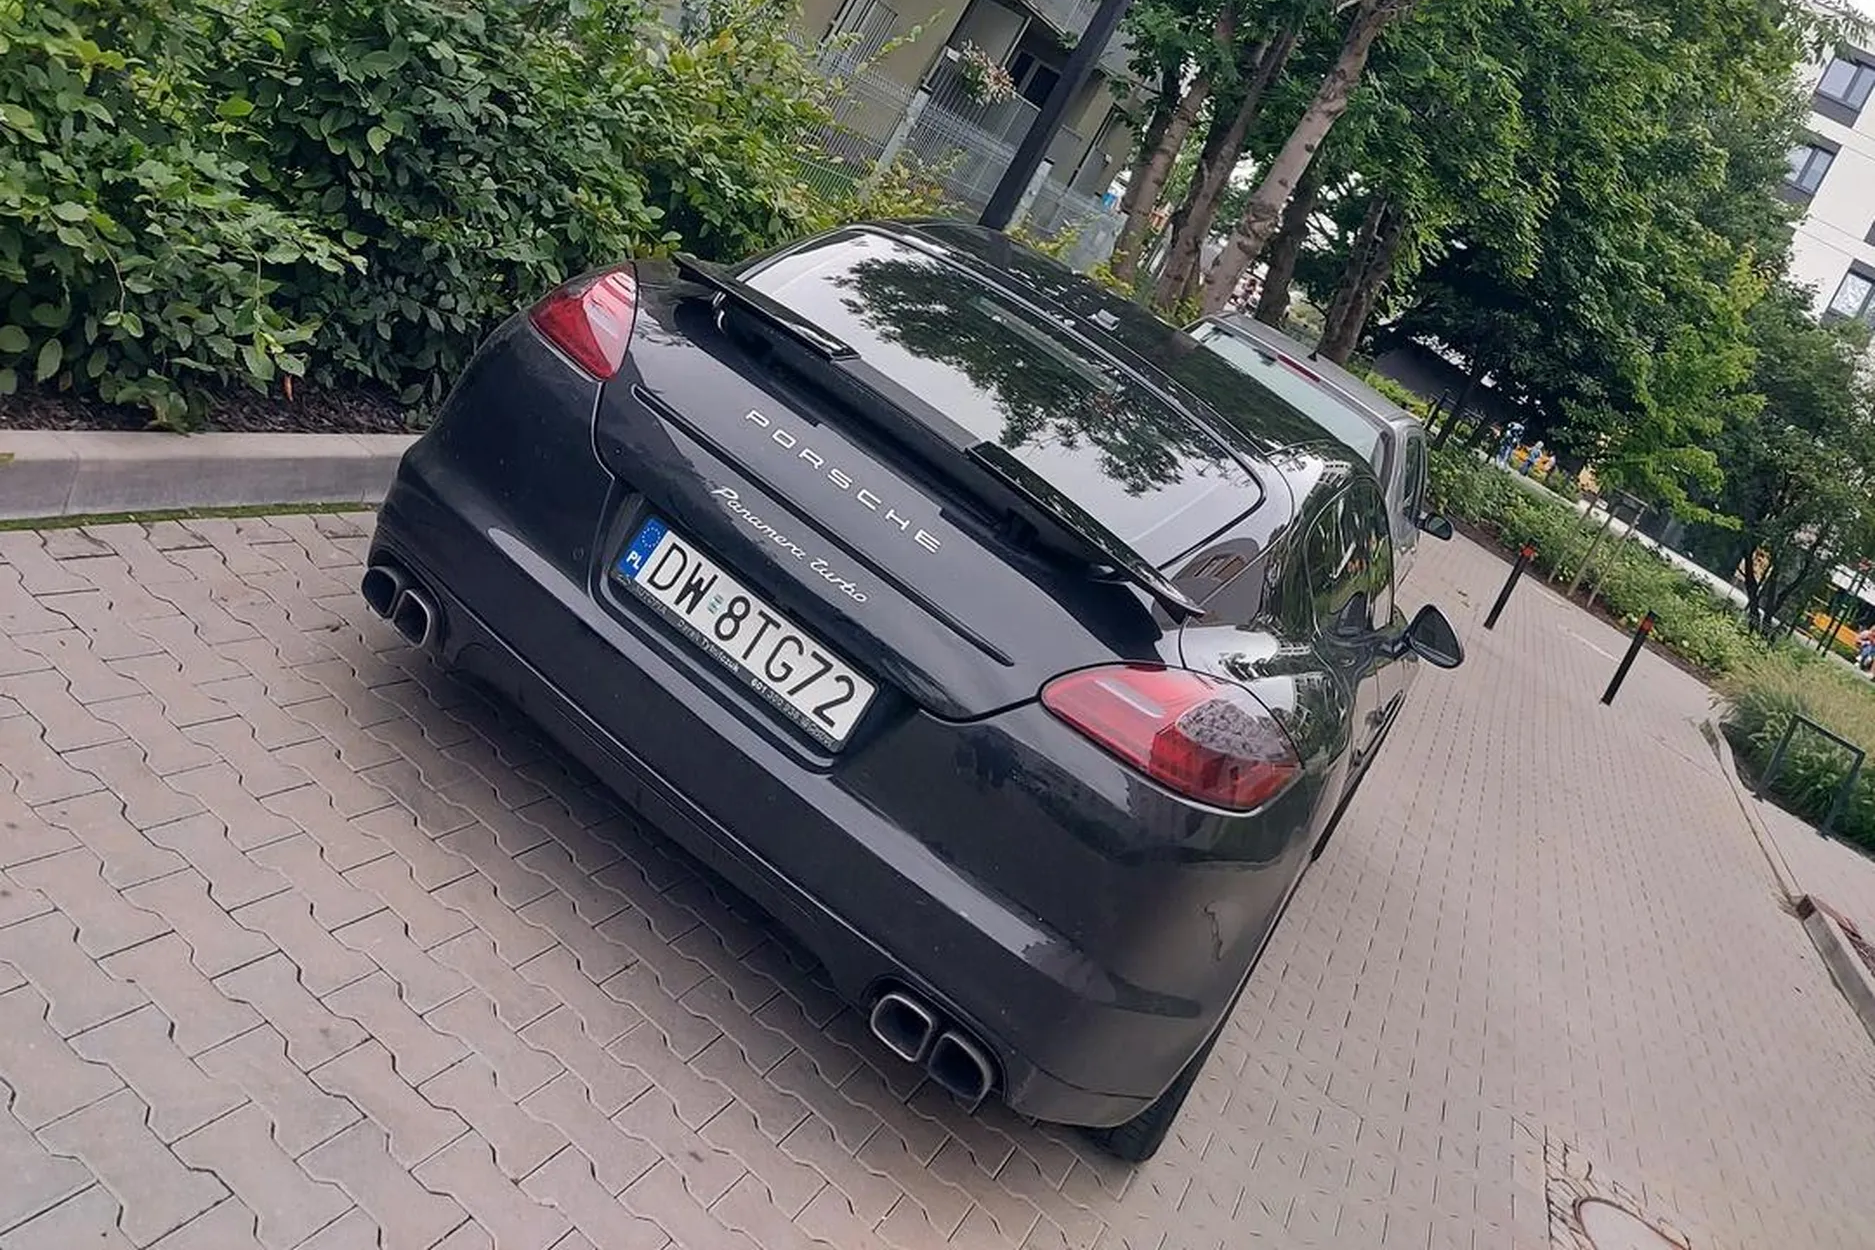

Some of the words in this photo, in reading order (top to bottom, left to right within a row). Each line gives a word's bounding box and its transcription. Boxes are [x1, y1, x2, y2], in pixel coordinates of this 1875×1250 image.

[711, 486, 807, 561] Panamera
[809, 557, 868, 603] turbo
[745, 410, 942, 554] PORSCHE
[626, 551, 644, 570] PL
[647, 542, 719, 616] DW
[714, 596, 856, 729] 8TG72
